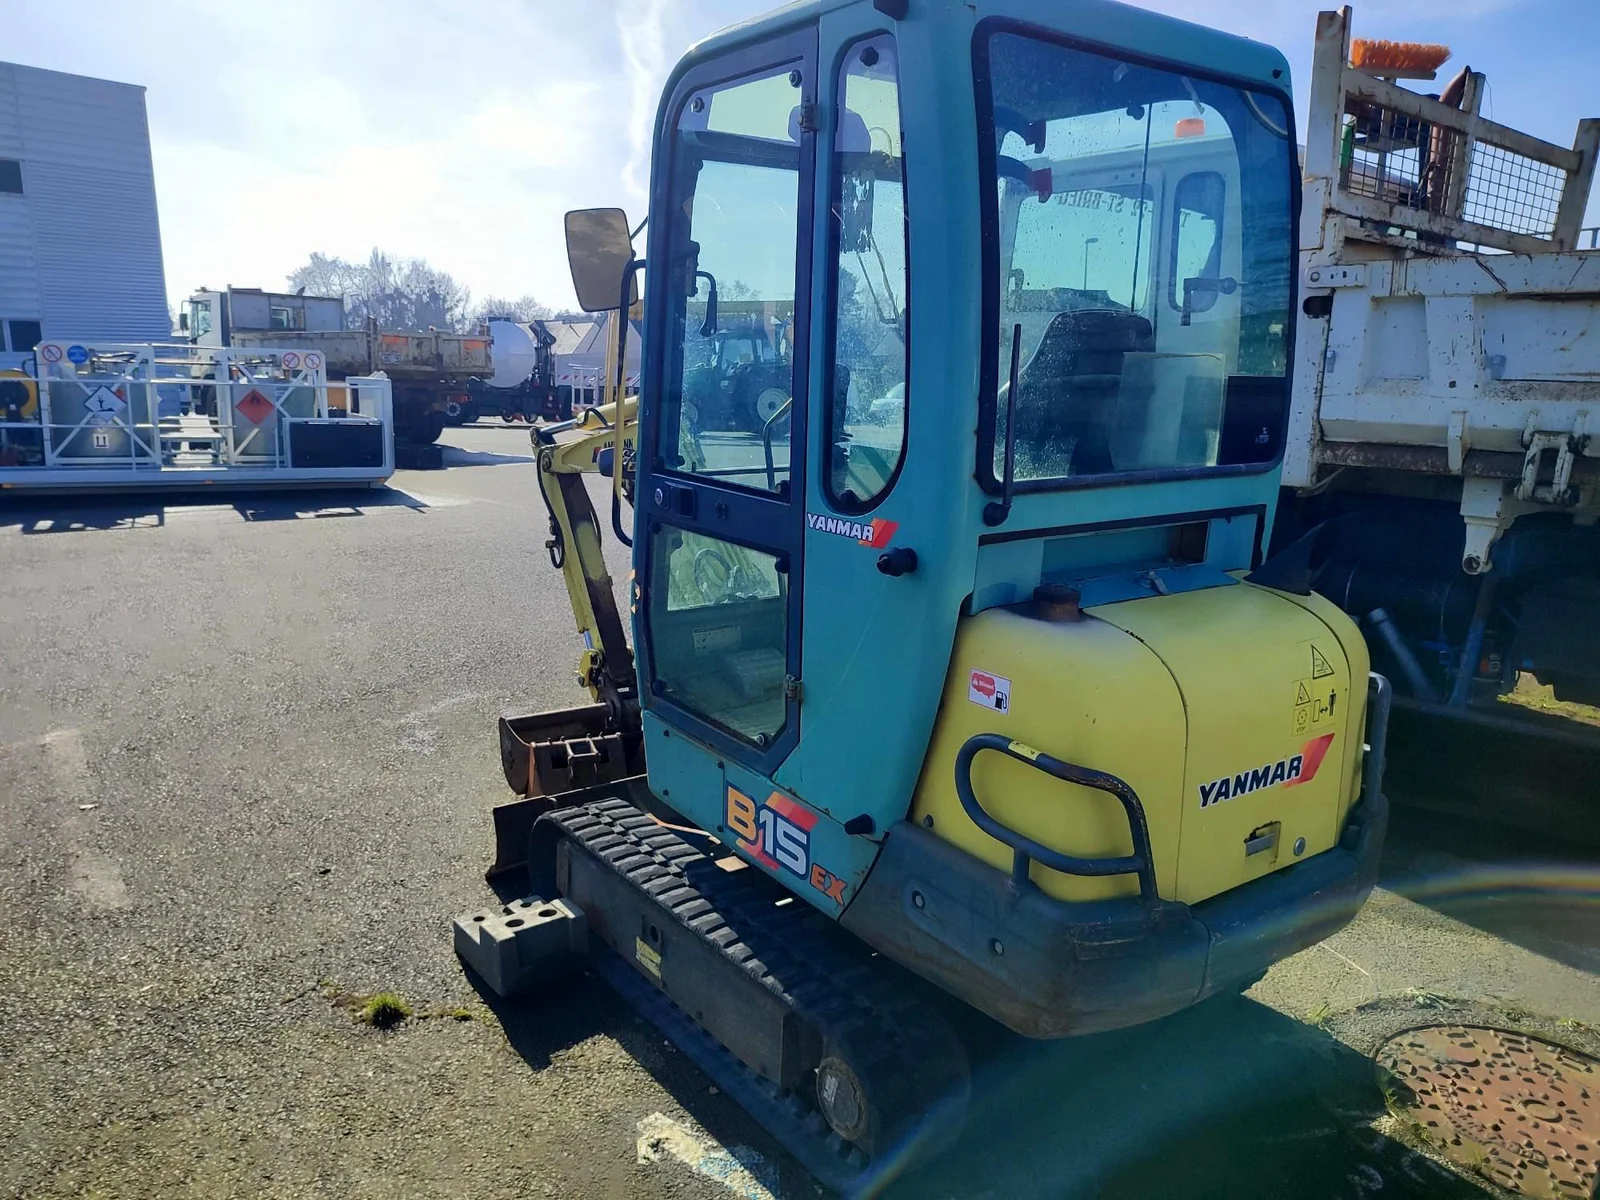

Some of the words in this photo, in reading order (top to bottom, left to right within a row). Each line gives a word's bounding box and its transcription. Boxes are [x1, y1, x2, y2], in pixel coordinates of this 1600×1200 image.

[807, 512, 875, 543] YANMAR
[1199, 754, 1303, 808] YANMAR
[726, 784, 808, 877] B15
[809, 862, 848, 907] EX
